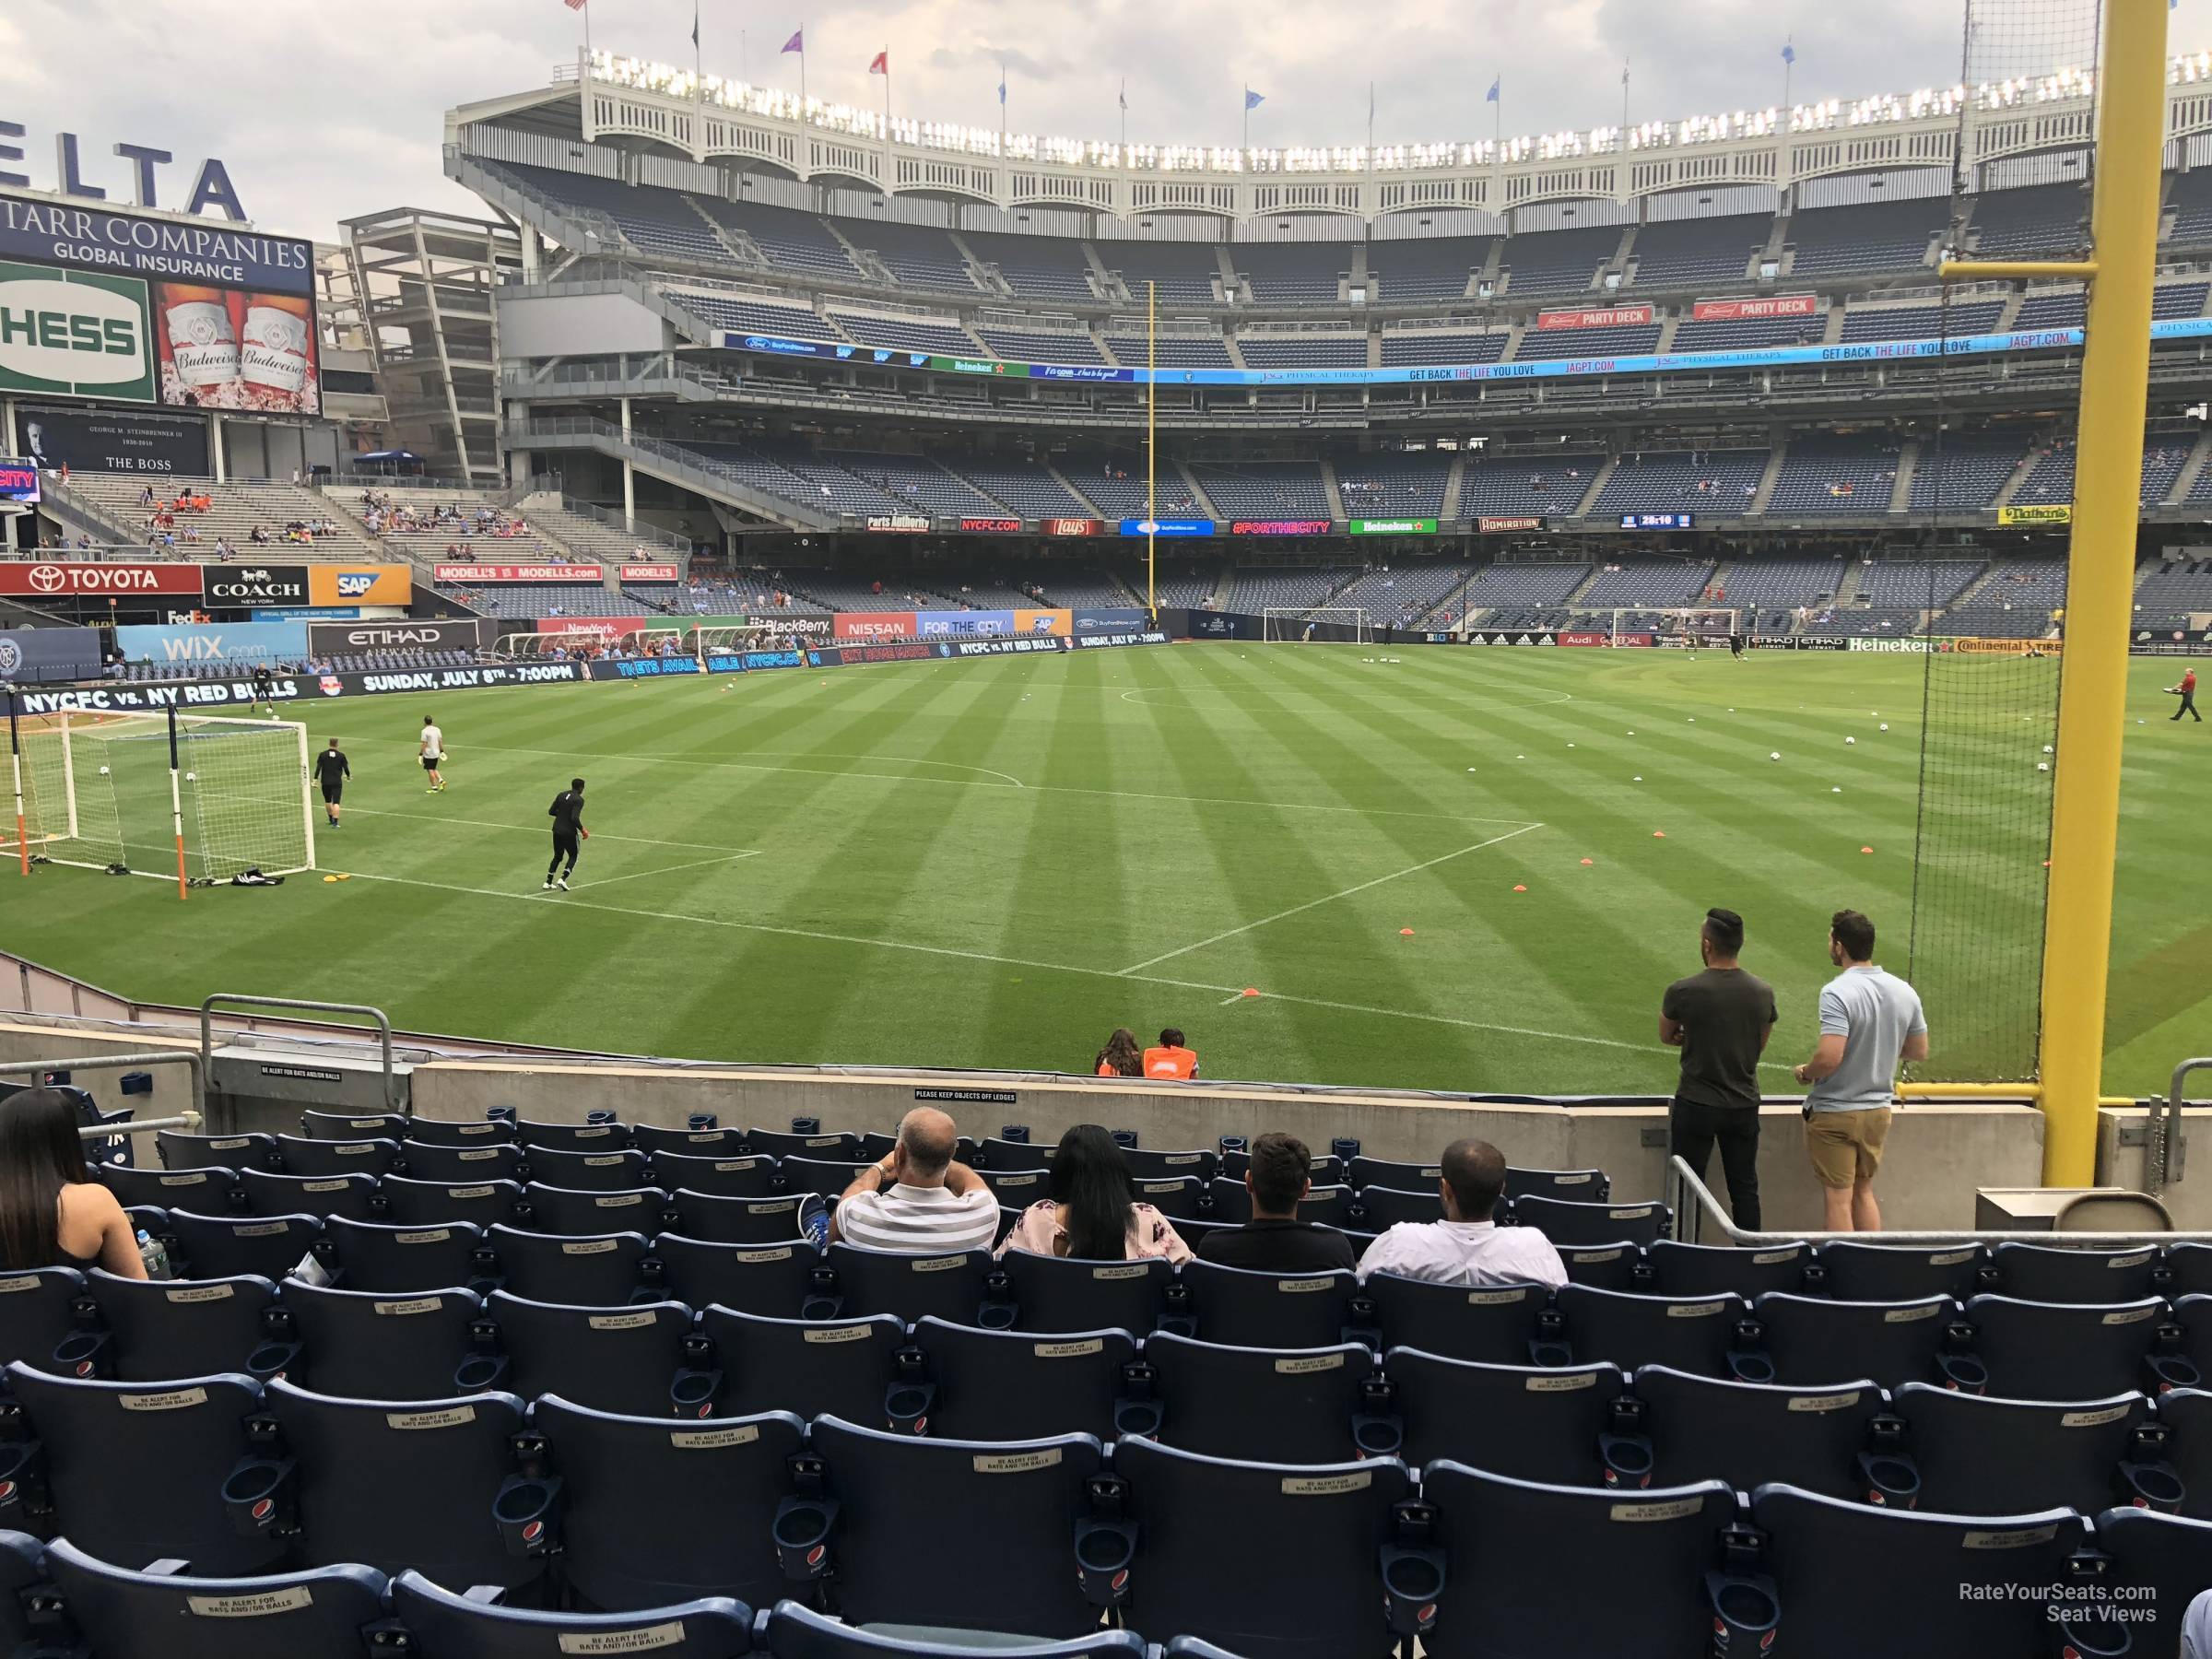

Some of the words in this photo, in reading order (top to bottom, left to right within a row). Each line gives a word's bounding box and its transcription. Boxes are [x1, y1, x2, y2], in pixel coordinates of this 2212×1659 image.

[107, 218, 307, 269] COMPANIES
[53, 241, 131, 267] GLOBAL
[135, 253, 244, 282] INSURANCE
[1740, 301, 1775, 315] PARTY
[1777, 299, 1808, 312] DECK
[1583, 312, 1614, 325] PARTY
[1617, 310, 1644, 323] DECK
[1, 306, 135, 356] HESS
[2007, 333, 2070, 348] JAGPT.COM
[836, 347, 852, 358] SAP
[874, 351, 889, 361] SAP
[1822, 348, 1841, 359] GET
[1844, 347, 1872, 359] BACK
[1875, 345, 1893, 357] THE
[1897, 344, 1917, 355] LIFE
[1921, 343, 1942, 354] YOU
[1945, 340, 1971, 352] LOVE
[910, 355, 925, 365] SAP
[1683, 352, 1733, 362] PHYSICAL
[1735, 351, 1781, 360] THERAPY
[954, 360, 993, 373] Heineken
[1410, 371, 1425, 381] GET
[1428, 370, 1452, 380] BACK
[1453, 369, 1470, 379] THE
[1474, 368, 1490, 378] LIFE
[1493, 367, 1512, 377] YOU
[1513, 365, 1535, 376] LOVE
[1565, 361, 1615, 373] JAGPT.COM
[89, 426, 116, 434] GEORGE
[127, 429, 175, 438] STEINBRENNER
[106, 456, 134, 469] THE
[138, 458, 171, 471] BOSS
[1641, 515, 1672, 524] 28:10
[2006, 507, 2069, 521] Nathan's
[867, 516, 890, 527] Parts
[890, 515, 930, 529] Authority
[961, 518, 1019, 532] NYCFC.COM
[1232, 521, 1330, 535] #FORTHECITY
[1363, 522, 1413, 532] Heineken
[1481, 519, 1537, 531] ADMIRATION
[67, 569, 159, 588] TOYOTA
[440, 567, 497, 579] MODELL'S
[518, 567, 598, 579] MODELLS.com
[625, 567, 673, 578] MODELL'S
[212, 583, 301, 596] COACH
[338, 576, 371, 594] SAP
[167, 609, 212, 625] FedEx
[848, 623, 905, 635] NISSAN
[924, 622, 949, 634] FOR
[952, 621, 974, 632] THE
[347, 629, 441, 645] ETIHAD
[1080, 636, 1112, 647] SUNDAY,
[1112, 635, 1126, 644] JULY
[1127, 633, 1137, 644] 8TH
[1141, 632, 1165, 643] 7:00PM
[1566, 635, 1593, 644] Audi
[1751, 636, 1794, 644] ETIHAD
[1800, 637, 1845, 645] ETIHAD
[959, 641, 990, 655] NYCFC
[1001, 641, 1014, 652] NY
[1015, 640, 1031, 652] RED
[1032, 639, 1057, 650] BULLS
[1848, 637, 1934, 653] Heineken
[1957, 640, 2023, 653] Continental
[2035, 642, 2063, 652] TIRE
[366, 647, 424, 657] AIRWAYS
[363, 673, 439, 691] SUNDAY,
[441, 670, 479, 688] JULY
[482, 668, 506, 684] 8TH
[516, 665, 574, 682] 7:00PM
[23, 689, 111, 713] NYCFC
[147, 686, 178, 706] NY
[184, 683, 229, 703] RED
[993, 1093, 1015, 1101] LEDGES
[266, 1599, 293, 1610] BALLS
[606, 1635, 631, 1643] ALERT
[633, 1632, 649, 1641] FOR
[641, 1636, 665, 1647] BALLS
